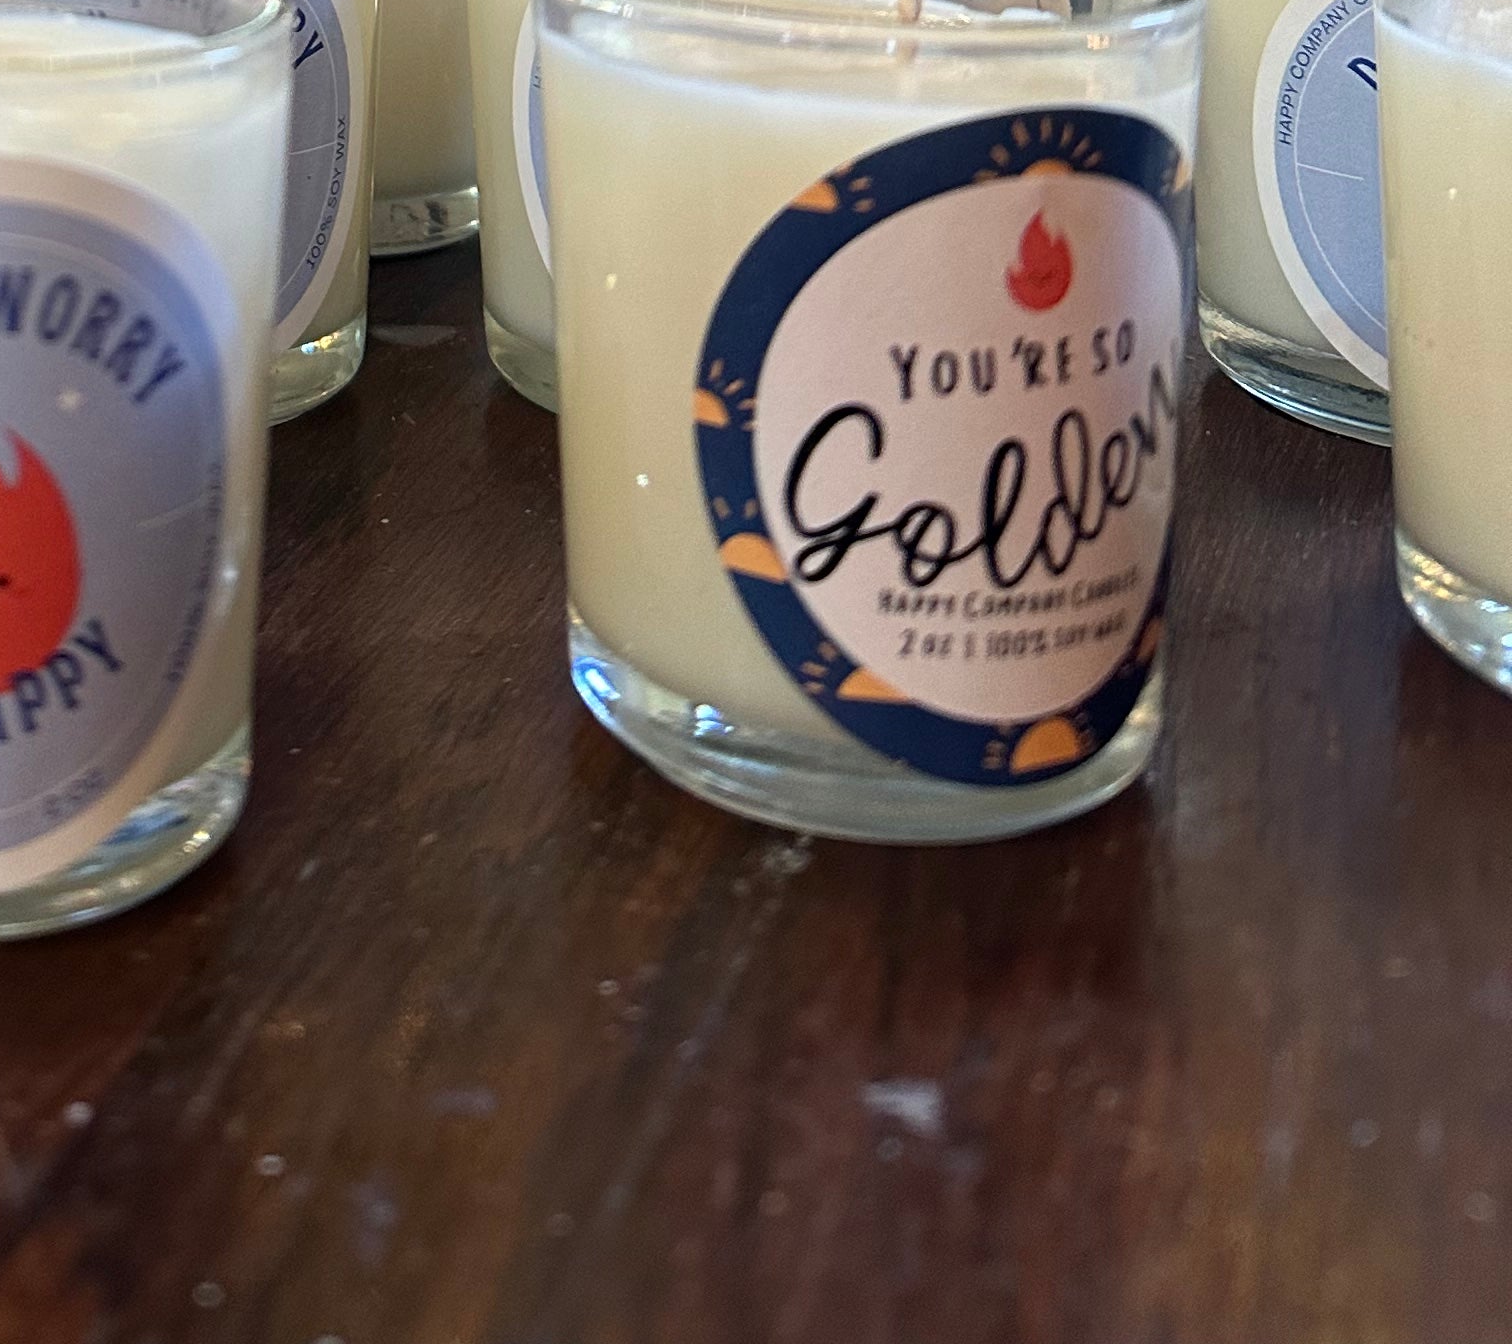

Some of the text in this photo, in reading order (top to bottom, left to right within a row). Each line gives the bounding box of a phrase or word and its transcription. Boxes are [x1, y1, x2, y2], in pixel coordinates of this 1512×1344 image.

[1278, 82, 1299, 145] HAPPY
[1290, 0, 1351, 80] COMPANY
[305, 115, 347, 271] 100% SOY WAX
[887, 318, 1137, 404] YOU'RE SO
[782, 334, 1180, 588] Golden
[898, 627, 917, 659] 2
[961, 583, 1067, 623] COMPANY
